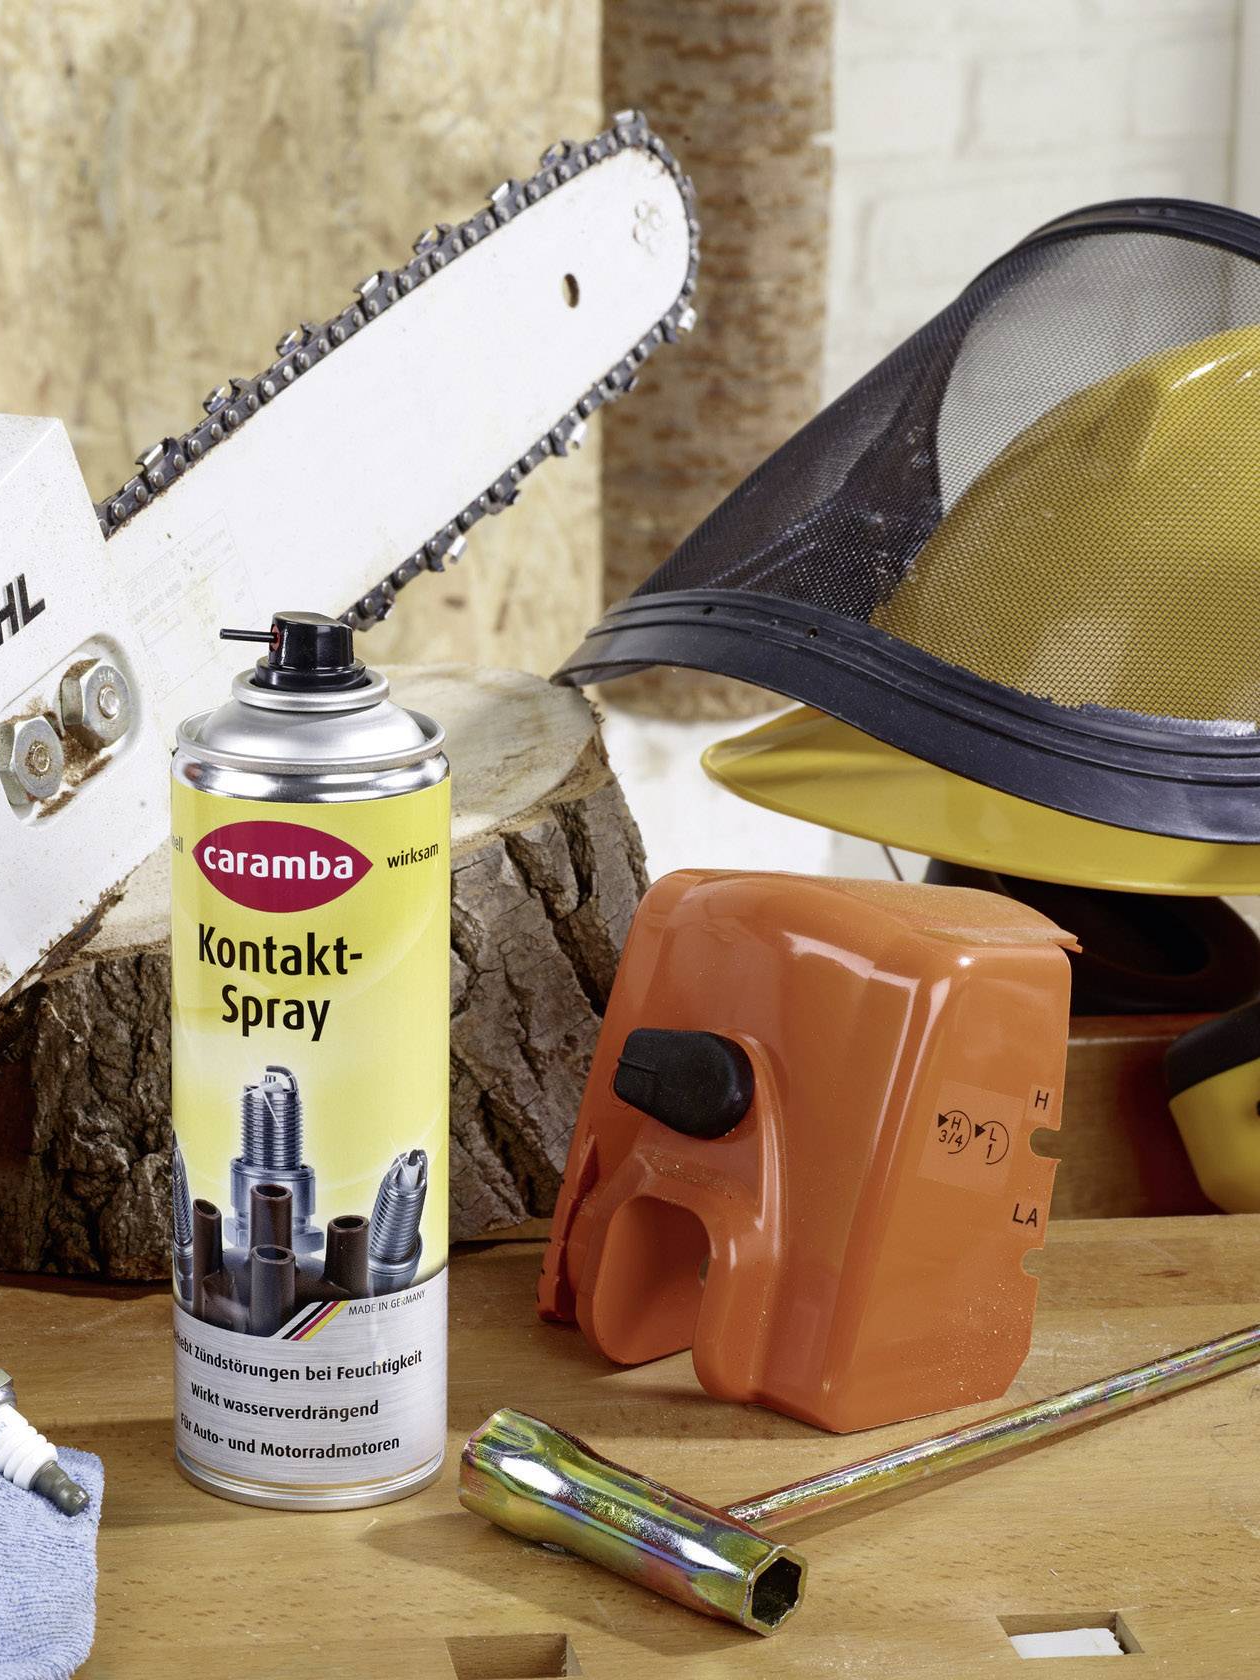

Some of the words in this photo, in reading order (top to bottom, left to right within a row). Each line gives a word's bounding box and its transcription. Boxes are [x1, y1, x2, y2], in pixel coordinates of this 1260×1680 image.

[204, 846, 354, 880] caramba
[387, 843, 439, 869] wirksam
[198, 923, 363, 976] Kontakt-
[221, 984, 331, 1042] Spray
[1034, 1090, 1049, 1110] H
[951, 1116, 962, 1131] H
[989, 1127, 997, 1142] L
[938, 1129, 963, 1148] 3/4
[986, 1143, 993, 1159] 1
[1012, 1203, 1038, 1228] LA
[348, 1303, 376, 1316] MADE
[378, 1301, 388, 1312] IN
[390, 1289, 426, 1309] GERMANY
[194, 1345, 300, 1382] Zündstörungen
[305, 1366, 331, 1381] bei
[337, 1349, 422, 1380] Feuchtigkeit
[191, 1382, 220, 1406] Wirkt
[223, 1400, 379, 1423] wasserverdrängend
[193, 1421, 224, 1445] Auto-
[228, 1435, 255, 1454] und
[260, 1437, 400, 1459] Motorradmotoren
